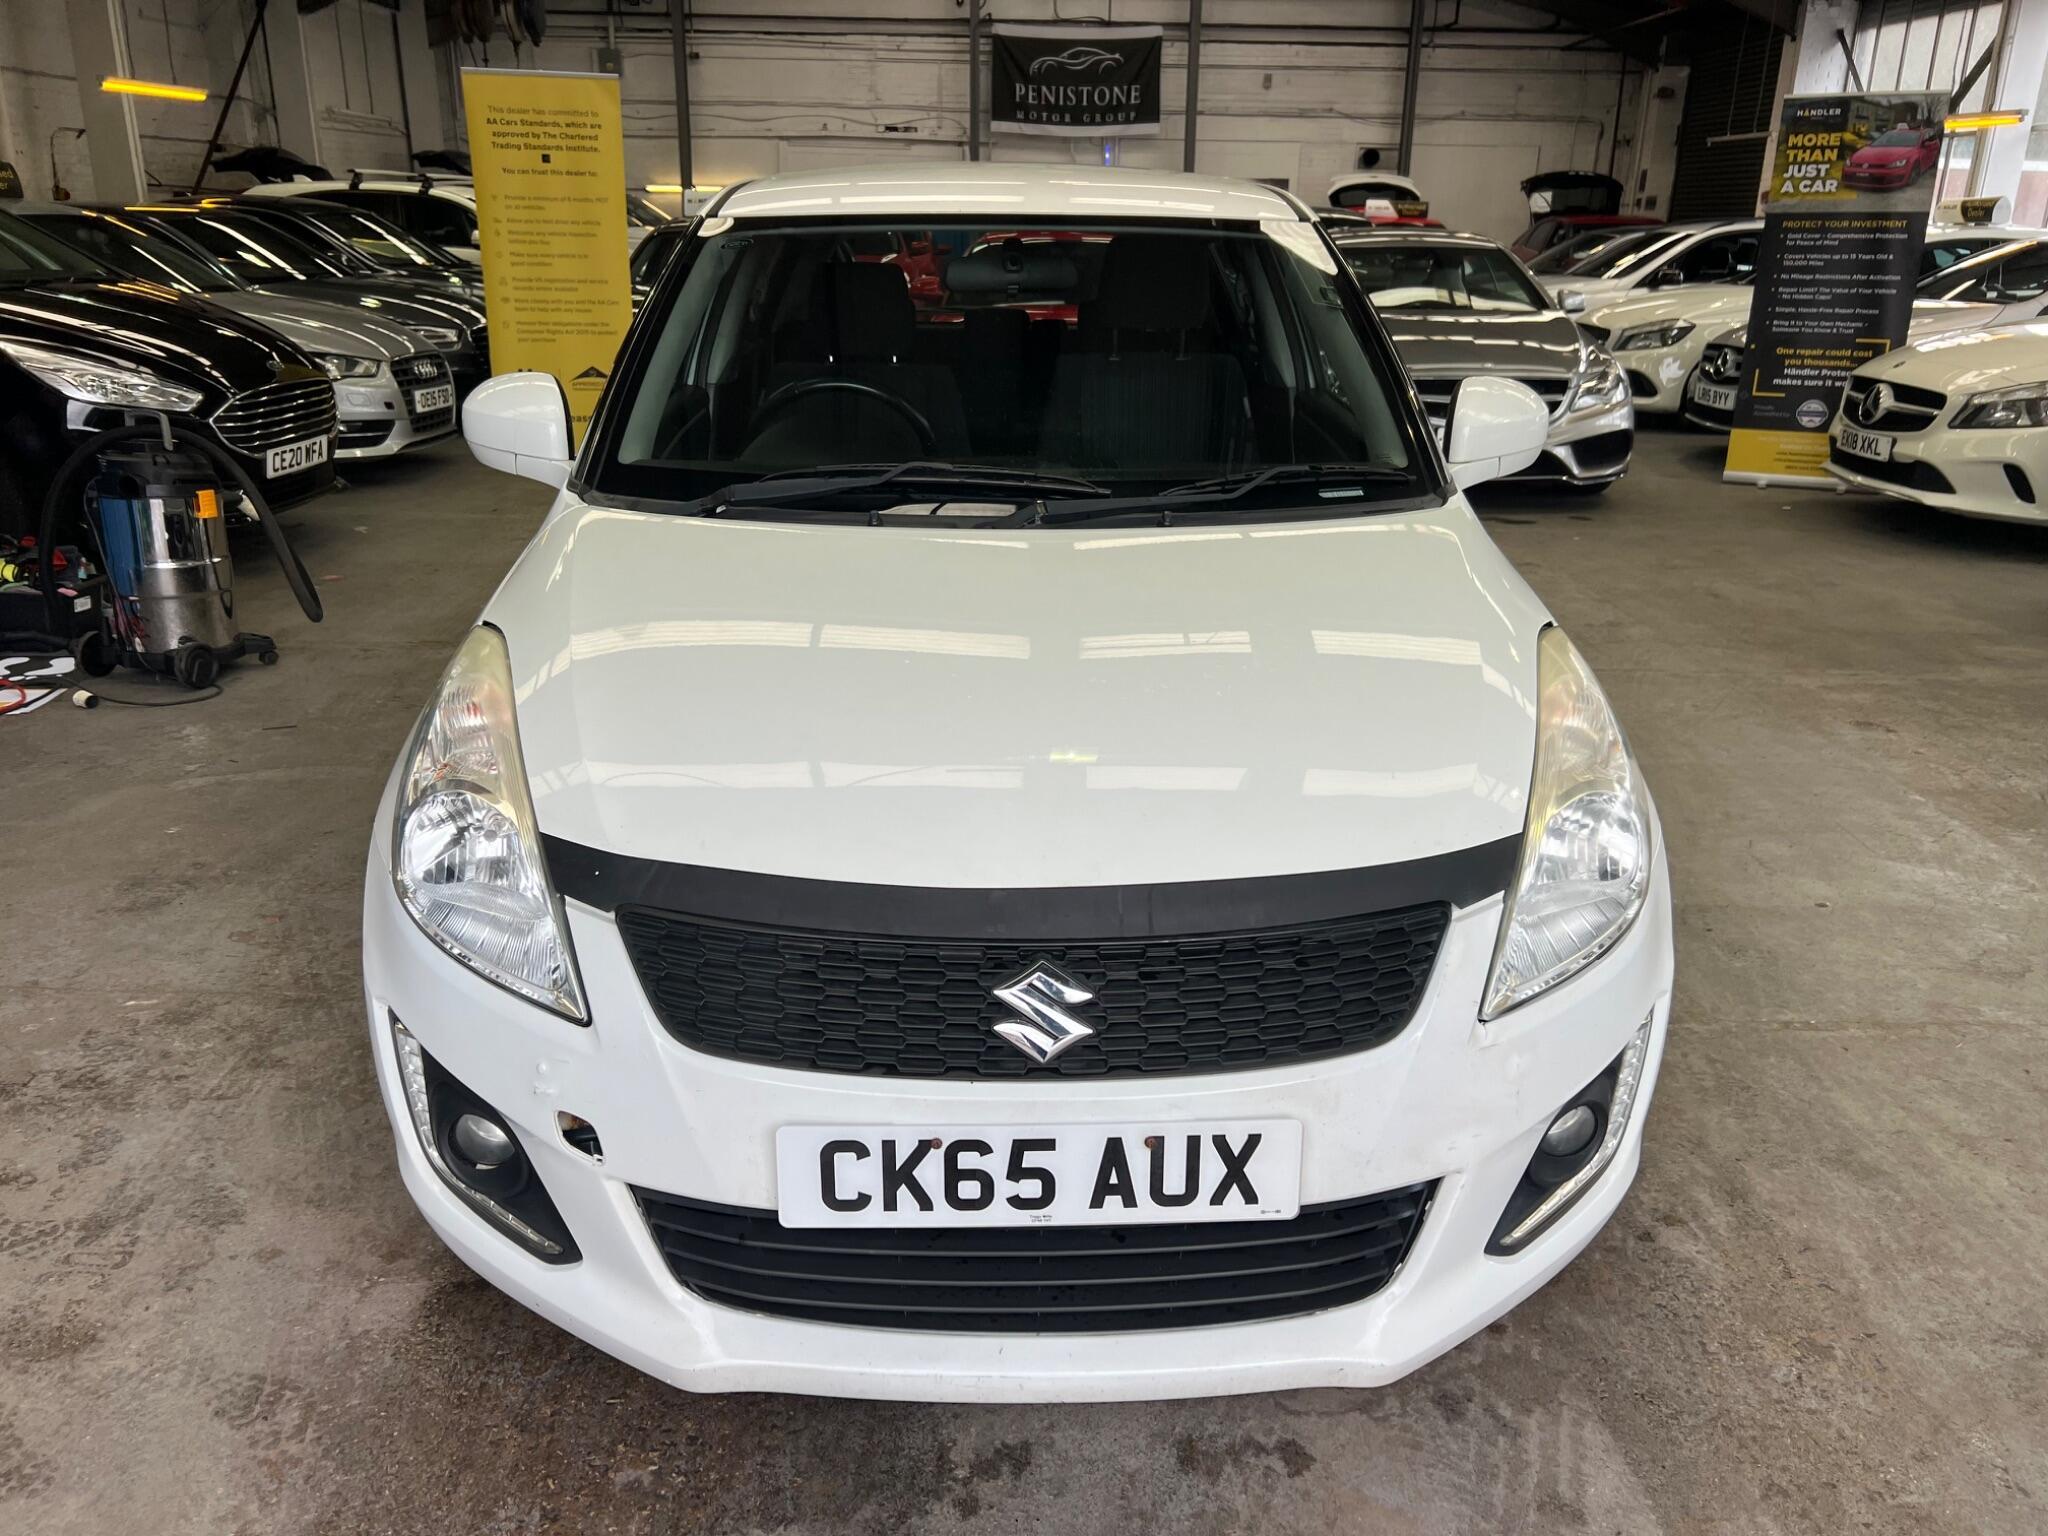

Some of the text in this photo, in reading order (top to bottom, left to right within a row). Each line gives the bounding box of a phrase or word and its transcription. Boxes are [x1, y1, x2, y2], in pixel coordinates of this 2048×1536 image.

[1016, 82, 1141, 106] PENISTONE
[1016, 110, 1137, 122] MOTOR GROUP
[486, 118, 498, 126] AA
[500, 118, 518, 126] Cars
[520, 119, 564, 128] Standards,
[565, 121, 588, 129] which
[492, 131, 598, 141] approved by The Chartered
[1788, 132, 1842, 148] MORE
[492, 142, 521, 151] Trading
[523, 143, 564, 151] Standards
[1786, 148, 1838, 162] THAN
[1783, 164, 1830, 178] JUST
[1780, 179, 1838, 194] A CAR
[1782, 220, 1908, 228] PROTECT YOUR INVESTMENT
[1776, 347, 1872, 357] One repair could cost
[1784, 359, 1802, 367] you
[1821, 369, 1851, 377] Protec
[1773, 378, 1802, 386] makes
[1825, 379, 1833, 387] it
[1859, 435, 1880, 456] XKL
[273, 446, 302, 472] CE20
[819, 1133, 1262, 1212] CK65 AUX
